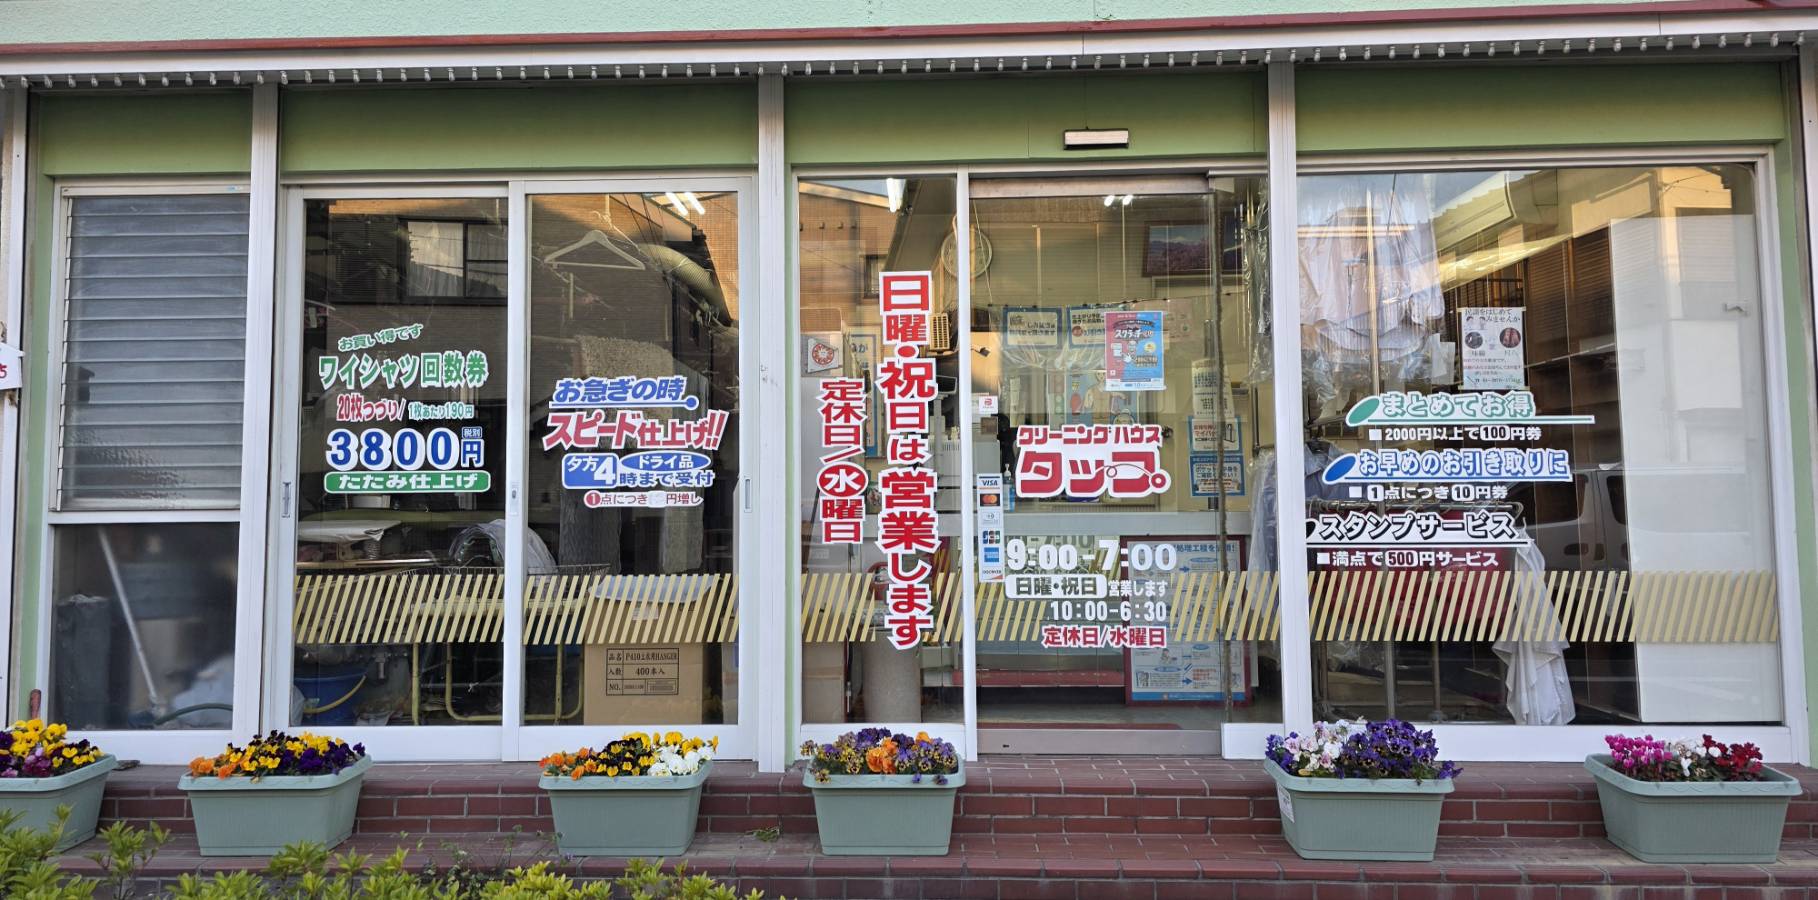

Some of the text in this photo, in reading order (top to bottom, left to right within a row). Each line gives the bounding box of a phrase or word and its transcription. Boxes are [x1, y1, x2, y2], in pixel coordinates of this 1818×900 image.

[338, 324, 423, 351] お買い得です
[320, 352, 488, 389] ワイシャツ回数券
[408, 402, 474, 420] 1枚あたり190円
[1383, 393, 1533, 418] まとめてお得
[464, 429, 481, 438] 税別
[328, 430, 483, 469] 3800円
[638, 455, 695, 469] ドライ品
[880, 274, 937, 648] 日曜・祝日は営業します
[1360, 450, 1569, 475] お早めのお引き取りに
[339, 474, 478, 489] たたみ仕上げ
[1319, 513, 1517, 541] スタンプサービス
